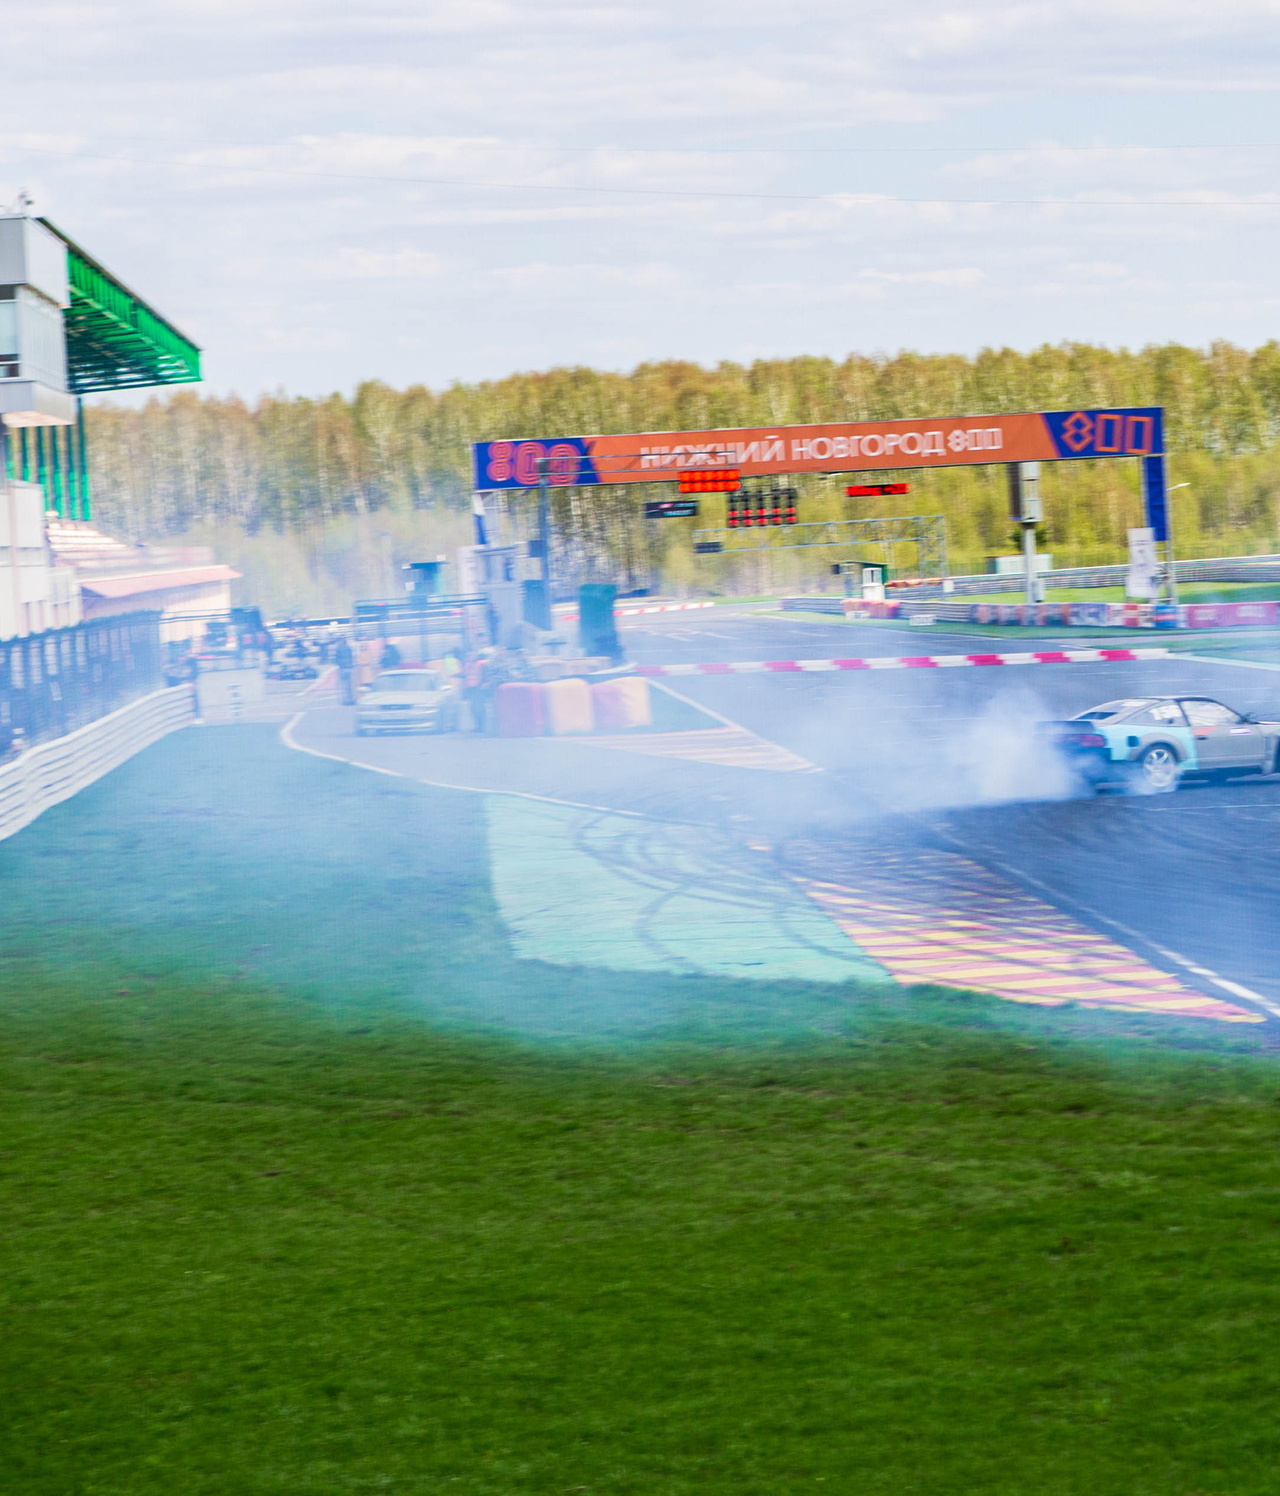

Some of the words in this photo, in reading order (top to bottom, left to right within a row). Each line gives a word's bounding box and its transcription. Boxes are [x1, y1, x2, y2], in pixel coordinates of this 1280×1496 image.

[640, 435, 785, 468] НИЖНИЙ
[791, 431, 947, 460] НОВГОРОД
[947, 428, 1003, 452] 800
[1061, 411, 1154, 454] 800
[486, 441, 582, 485] 800
